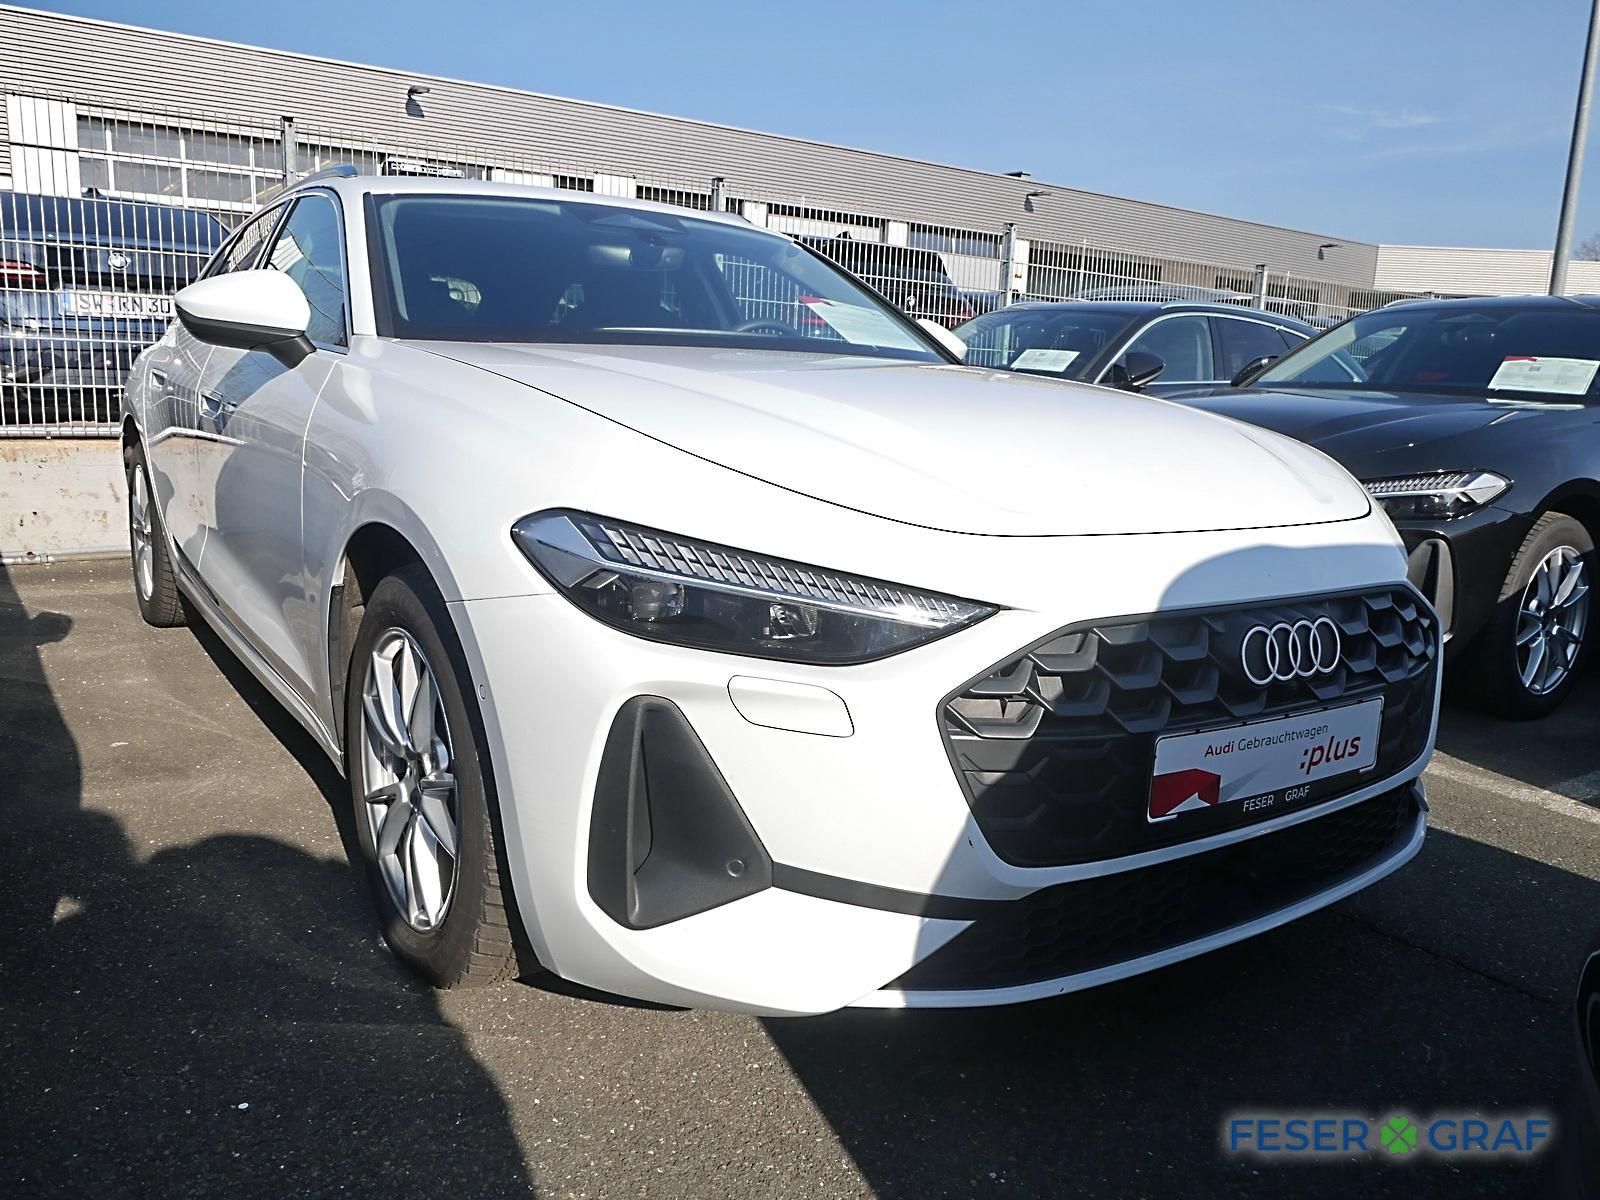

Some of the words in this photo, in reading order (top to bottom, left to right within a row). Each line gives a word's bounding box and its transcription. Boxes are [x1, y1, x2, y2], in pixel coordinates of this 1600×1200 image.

[118, 297, 143, 312] RN
[1204, 740, 1235, 758] Audi
[1237, 724, 1329, 752] Gebrauchtwagen
[1299, 735, 1361, 775] :plus
[1242, 794, 1275, 813] FESER
[1285, 785, 1311, 802] GRAF
